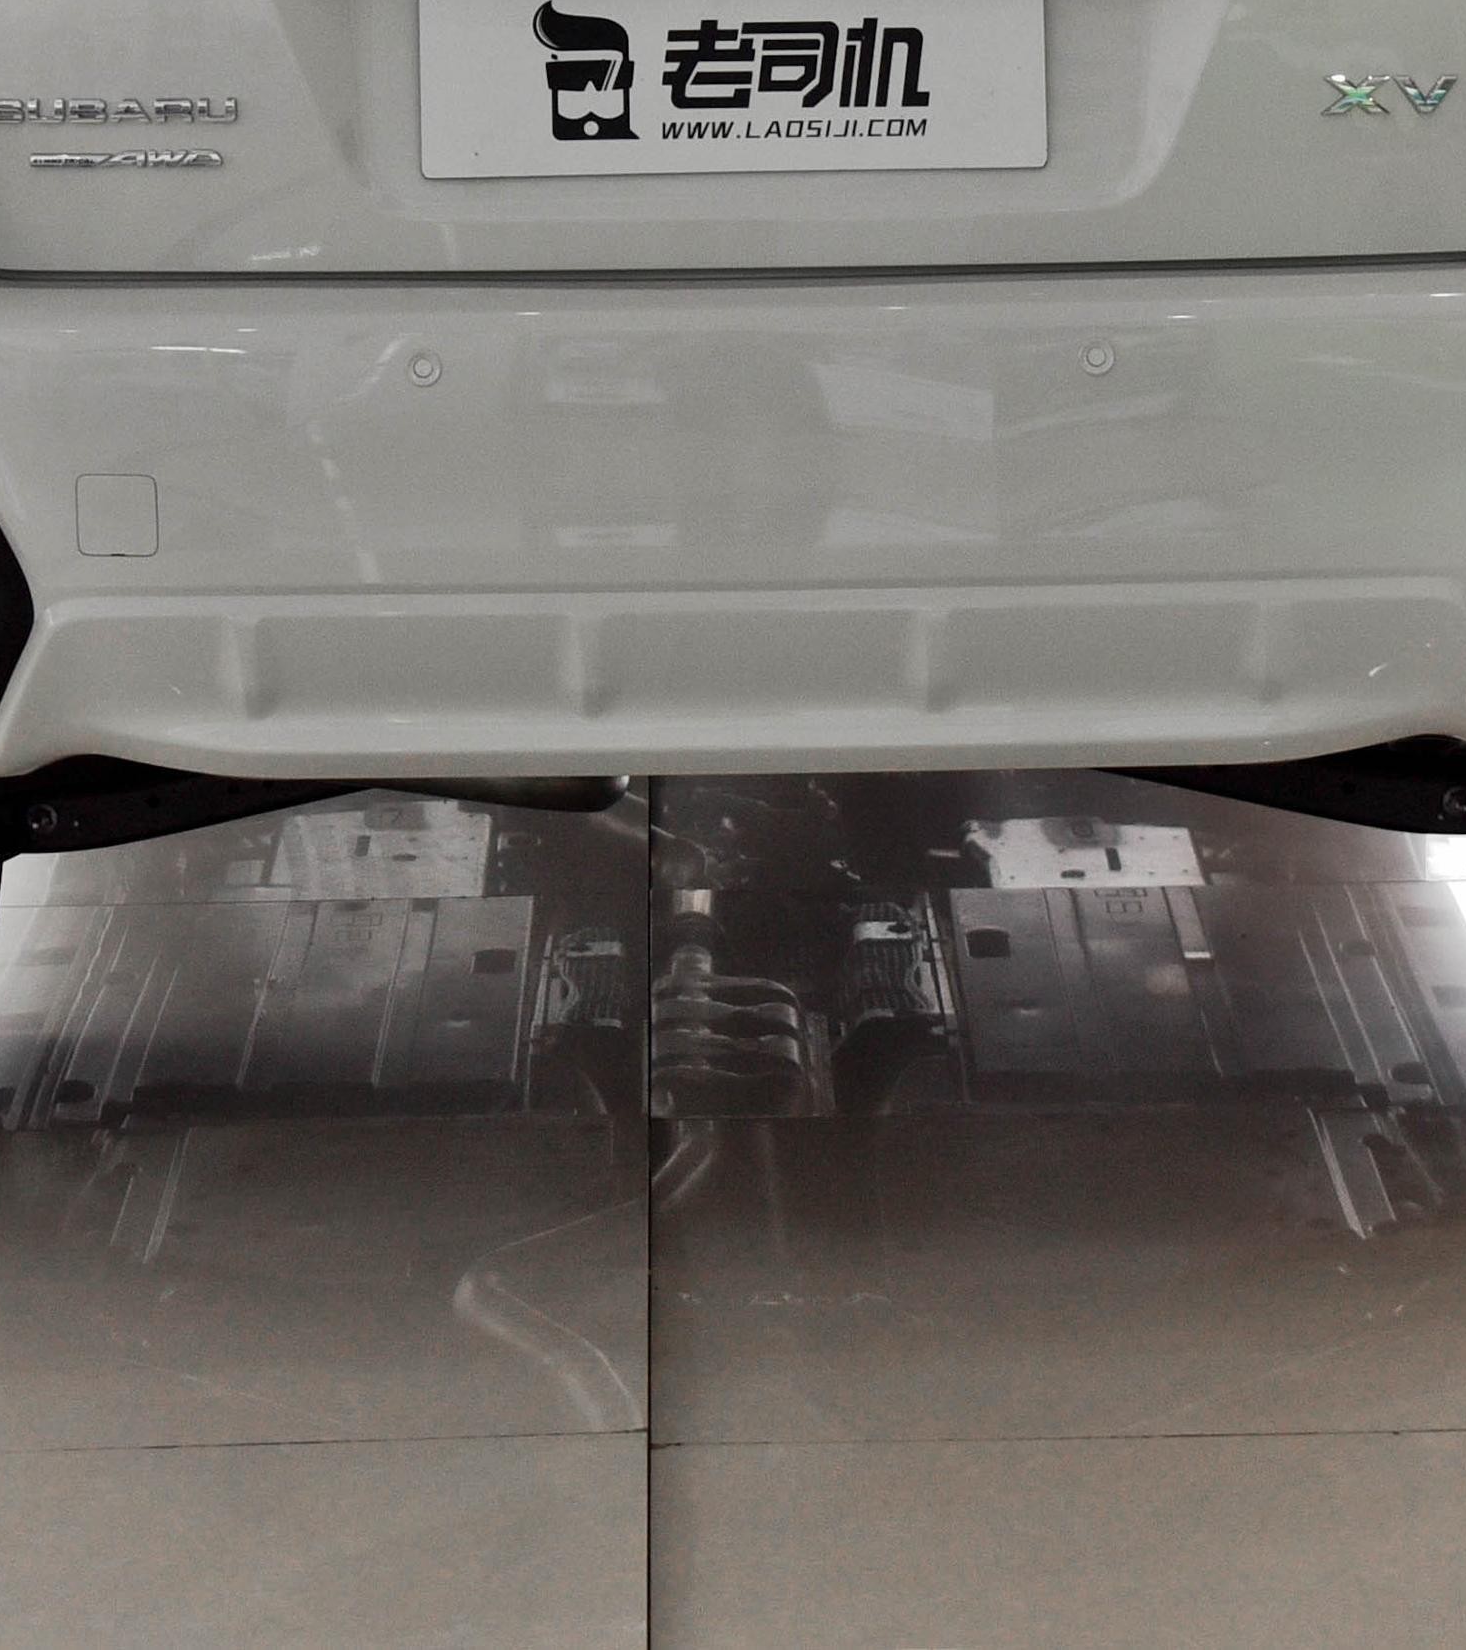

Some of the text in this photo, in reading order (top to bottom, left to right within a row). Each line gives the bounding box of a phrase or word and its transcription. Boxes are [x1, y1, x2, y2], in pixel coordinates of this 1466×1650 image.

[662, 18, 930, 108] 老司机
[1321, 74, 1458, 114] XV
[661, 119, 928, 140] WWW.LAOSIJI.COM
[103, 149, 223, 167] AWD
